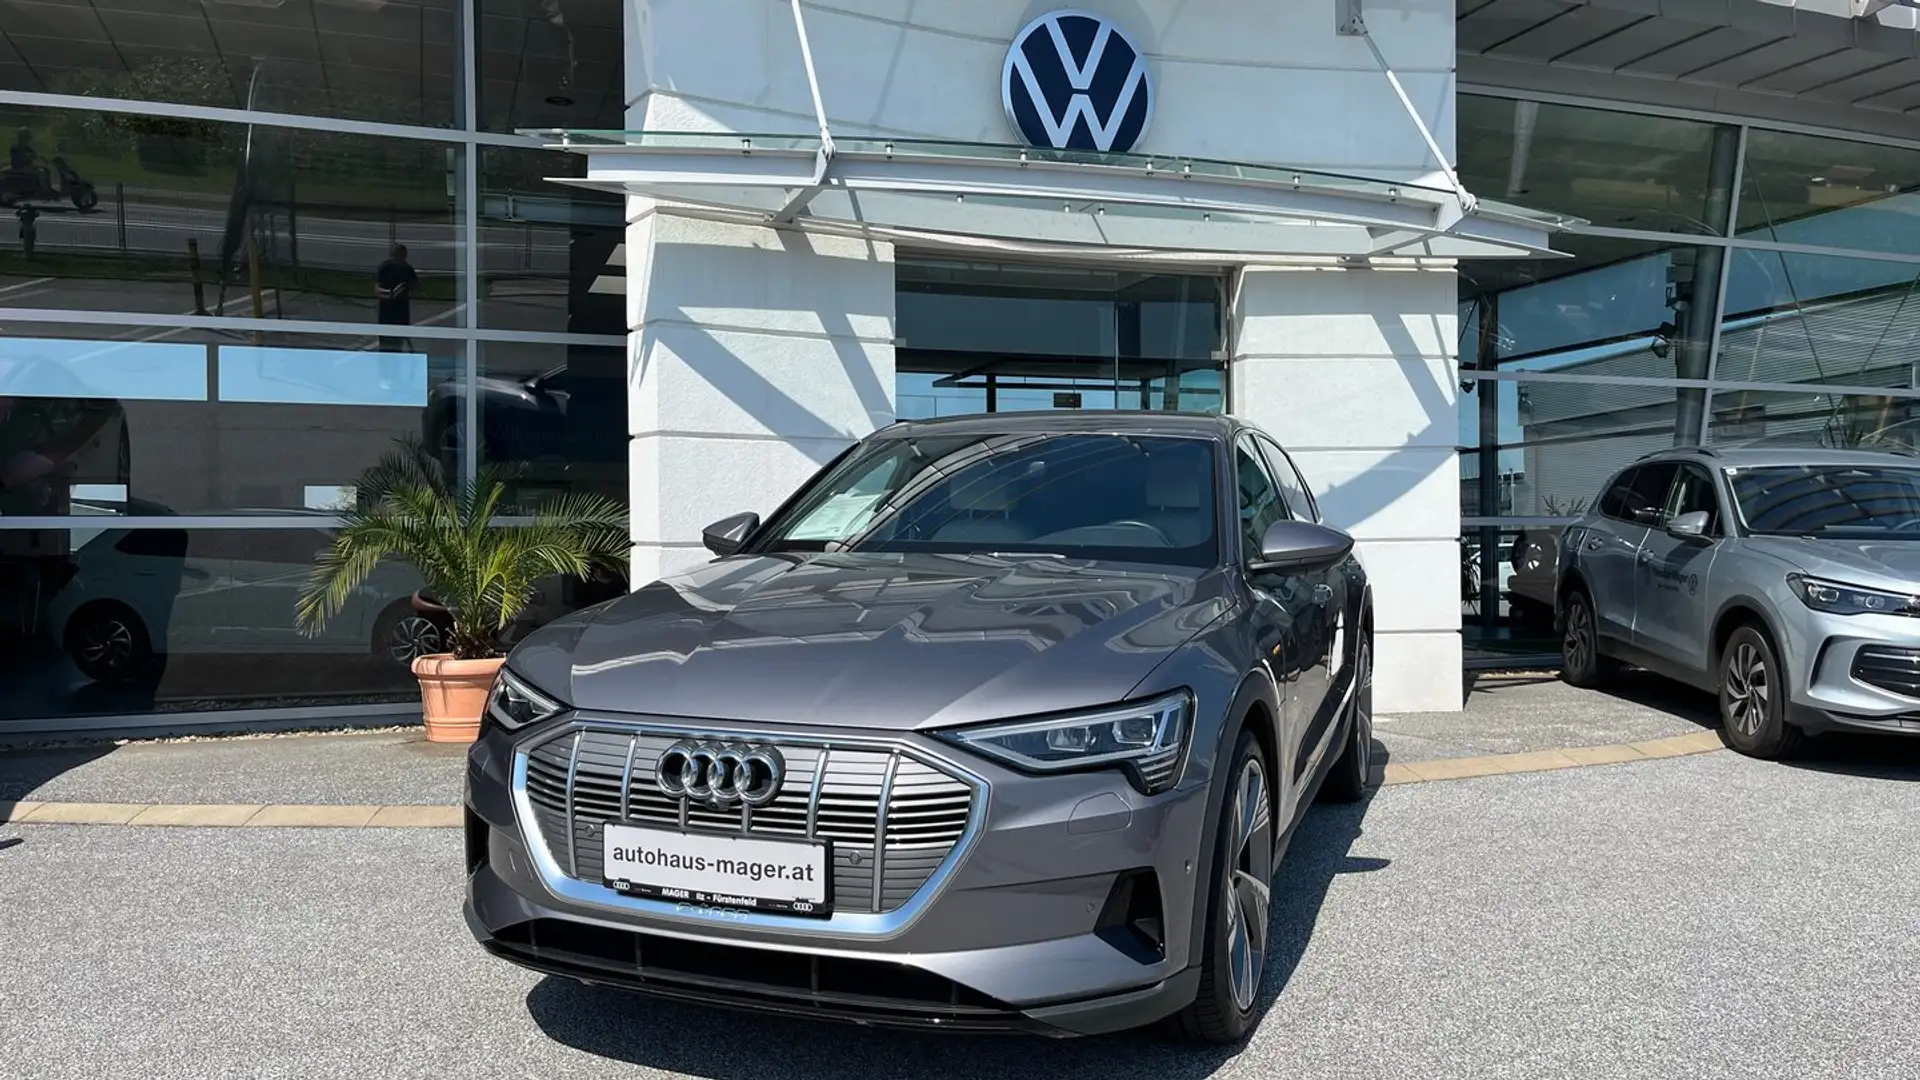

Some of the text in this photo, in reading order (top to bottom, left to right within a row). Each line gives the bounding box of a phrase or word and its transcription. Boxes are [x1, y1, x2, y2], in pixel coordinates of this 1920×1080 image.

[1006, 14, 1149, 152] VW
[613, 847, 813, 881] autohaus-mager.at
[661, 888, 690, 899] MAGER
[712, 893, 757, 907] Fürstenfeld
